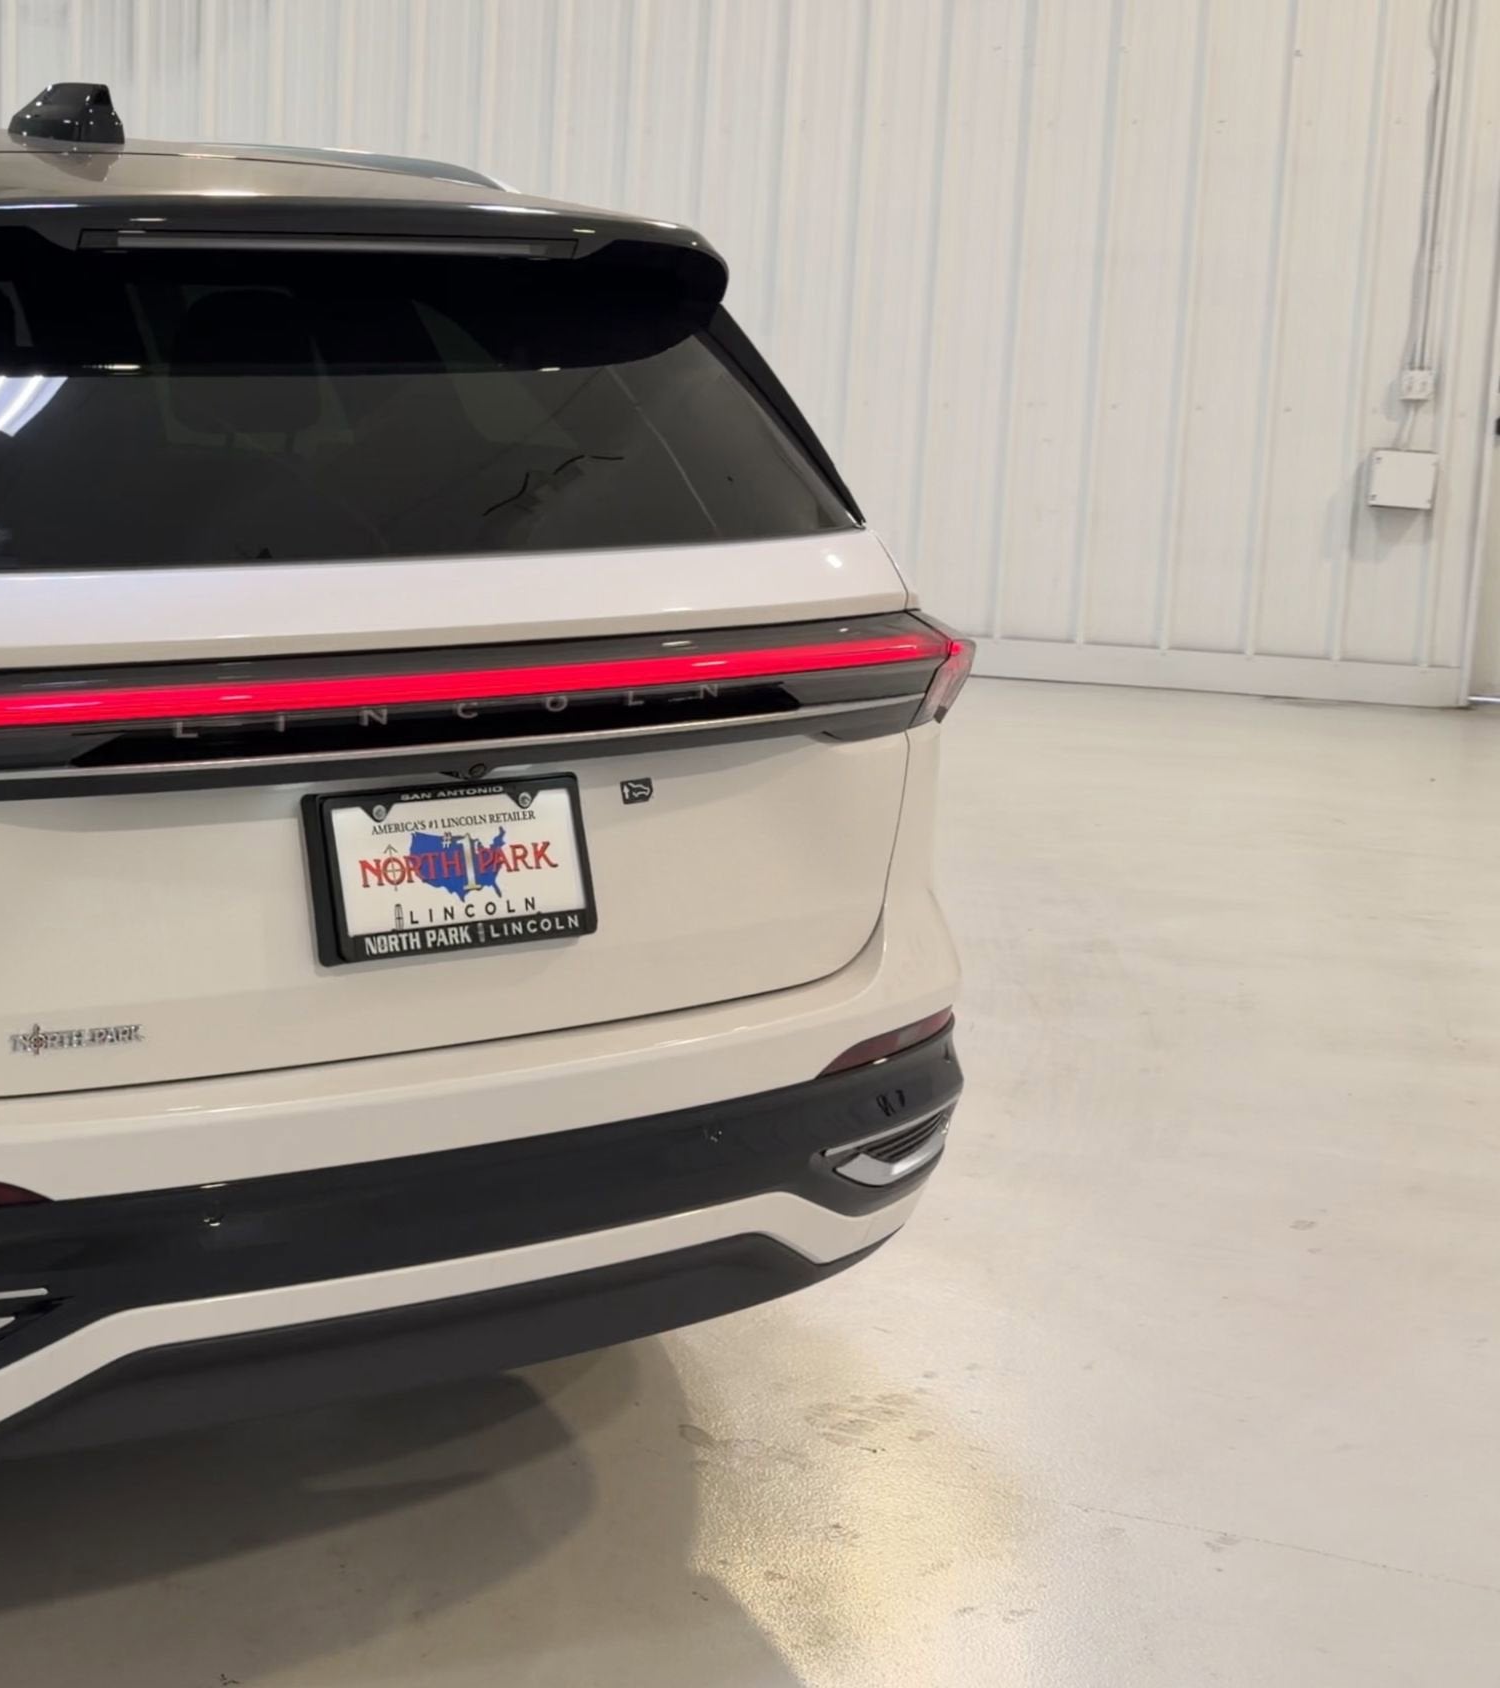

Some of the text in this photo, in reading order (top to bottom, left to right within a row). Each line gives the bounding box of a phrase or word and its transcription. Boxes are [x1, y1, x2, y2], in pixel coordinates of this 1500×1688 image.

[173, 682, 720, 739] LINCOLN
[400, 785, 504, 801] SAN ANTONIO
[371, 810, 536, 836] AMERICA'S #1 LINCOLN RETAILER
[358, 841, 559, 888] NORTH PARK
[409, 896, 536, 925] LINCOLN
[364, 914, 580, 956] NORTH PARK LINCOLN
[9, 1024, 145, 1053] NORTH PARK
